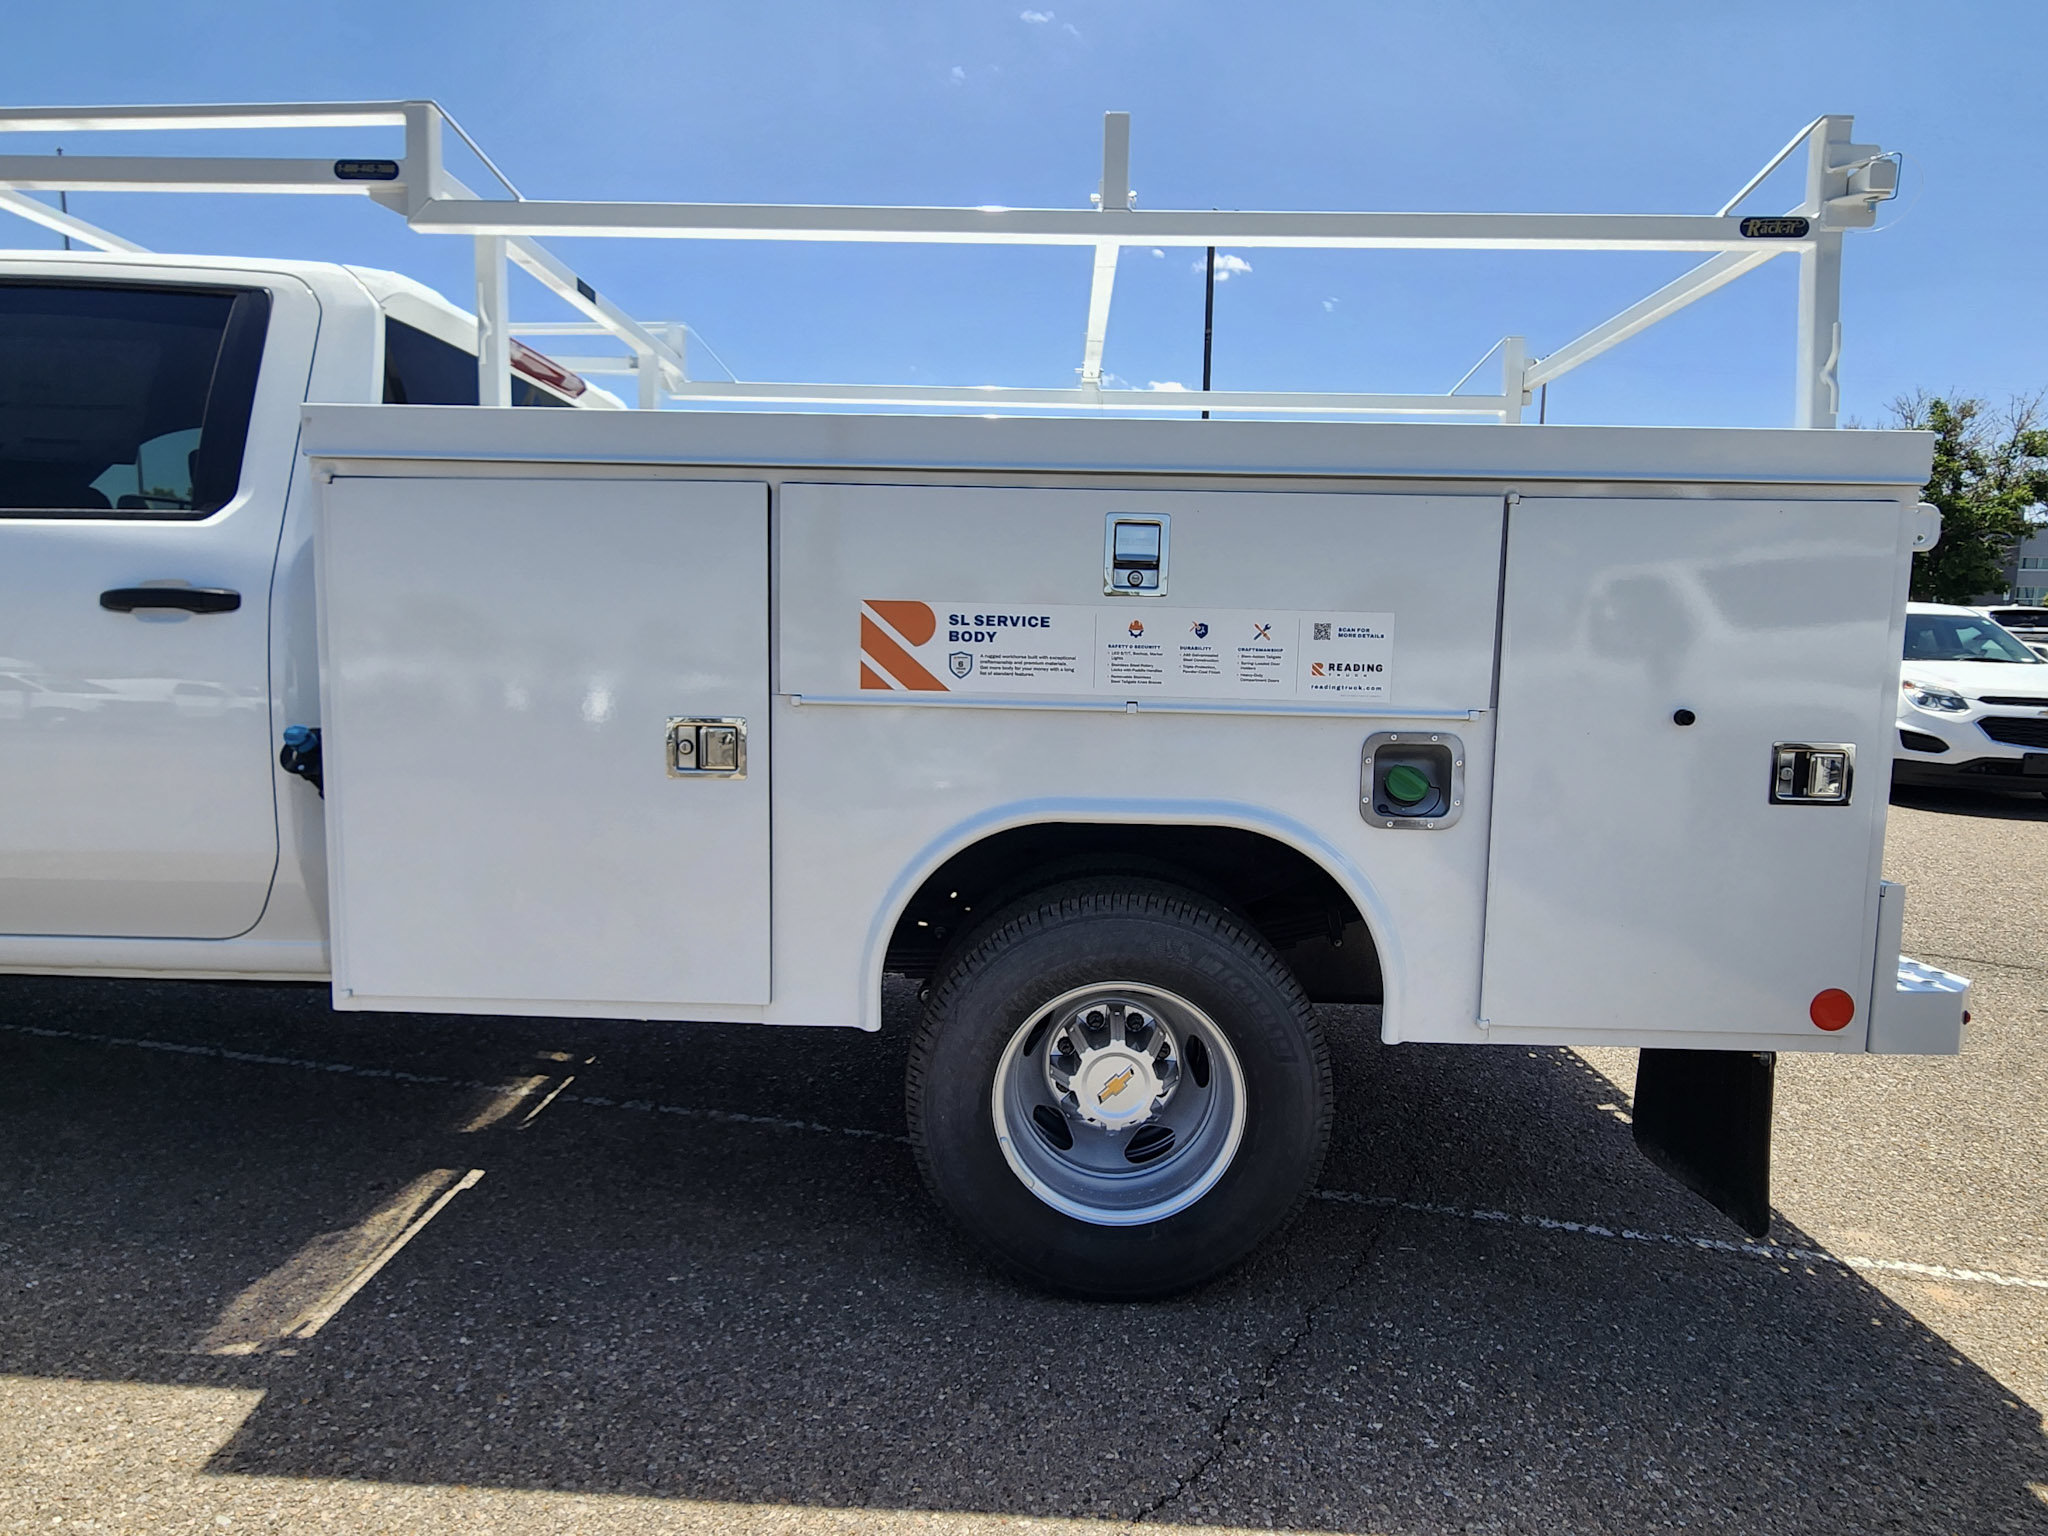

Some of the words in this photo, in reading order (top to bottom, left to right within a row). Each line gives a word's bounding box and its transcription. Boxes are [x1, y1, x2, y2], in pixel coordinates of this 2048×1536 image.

[948, 614, 970, 626] SL
[974, 614, 1050, 628] SERVICE
[948, 630, 997, 642] BODY
[1328, 663, 1383, 672] READING
